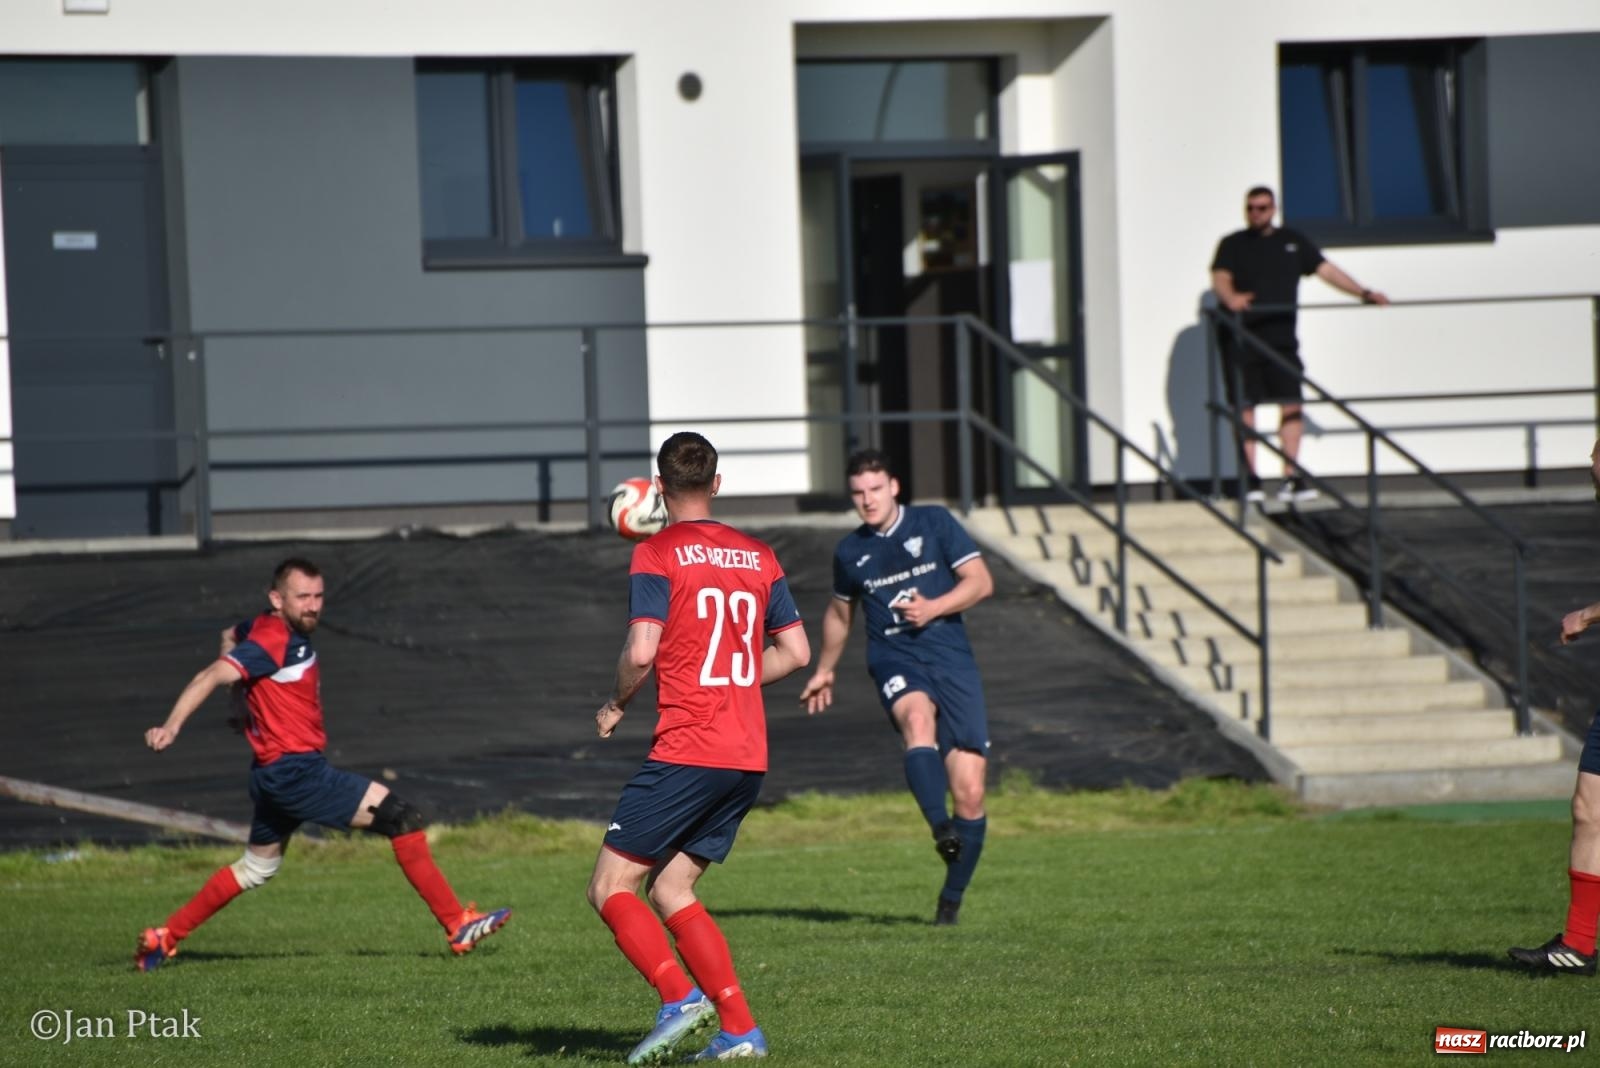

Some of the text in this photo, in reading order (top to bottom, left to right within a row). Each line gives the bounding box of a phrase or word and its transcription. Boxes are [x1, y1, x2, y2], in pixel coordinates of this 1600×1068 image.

[675, 544, 761, 571] LKS BRZEZIE
[696, 587, 757, 687] 23
[883, 675, 907, 699] 13
